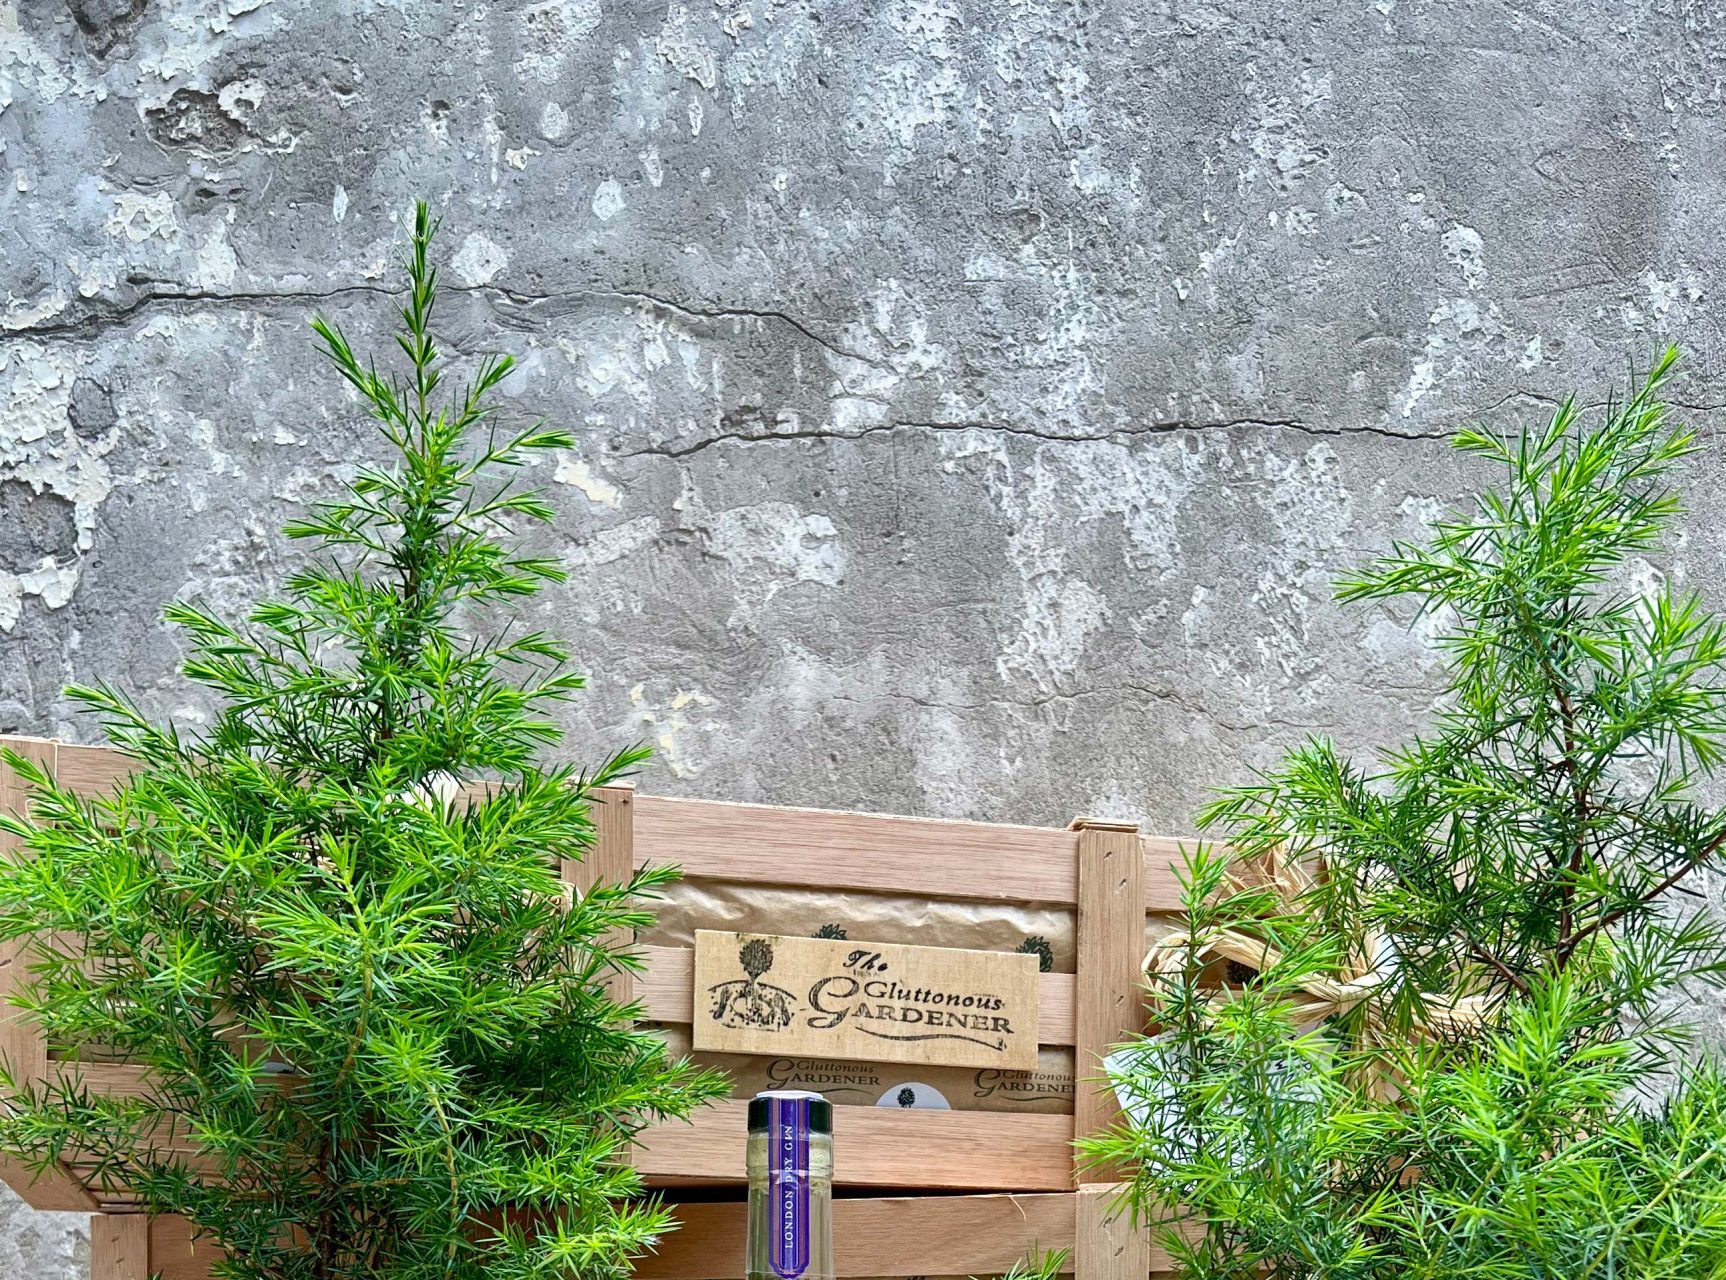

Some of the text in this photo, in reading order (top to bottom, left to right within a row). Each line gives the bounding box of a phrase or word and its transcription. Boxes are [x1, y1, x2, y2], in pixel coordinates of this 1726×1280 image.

[843, 950, 889, 973] The
[808, 976, 1015, 1034] GARDENER
[864, 980, 1005, 1011] Gluttonous
[766, 1059, 881, 1090] GARDENER
[796, 1060, 875, 1074] Gluttonous
[784, 1125, 794, 1249] LONDON DRY GIN
